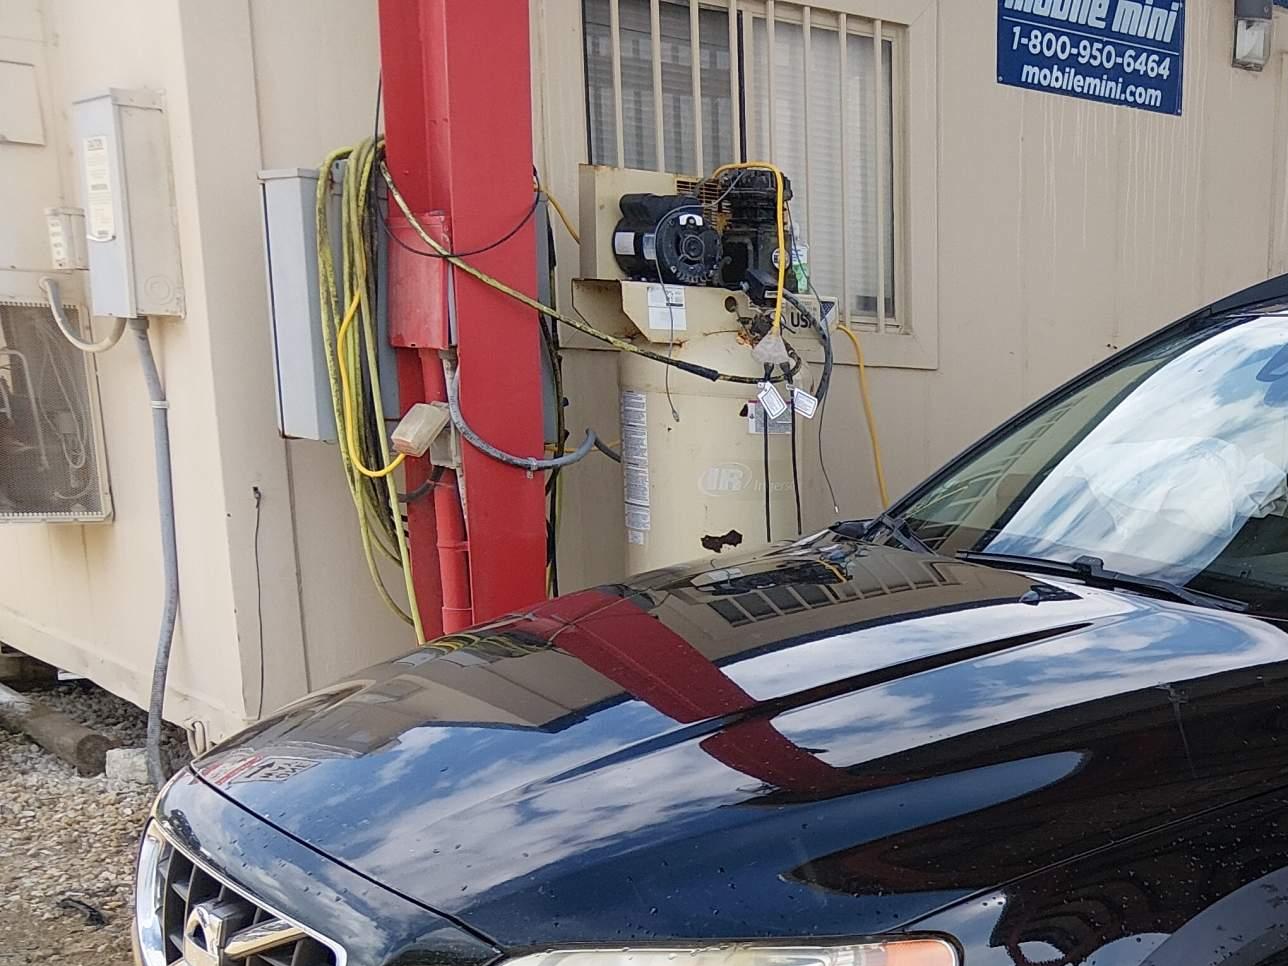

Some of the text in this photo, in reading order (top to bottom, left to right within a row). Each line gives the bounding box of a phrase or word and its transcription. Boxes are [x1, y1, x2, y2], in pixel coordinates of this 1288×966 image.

[1111, 0, 1180, 43] mini
[1011, 26, 1170, 79] 1-800-950-6464
[1020, 63, 1162, 107] mobilemini.com
